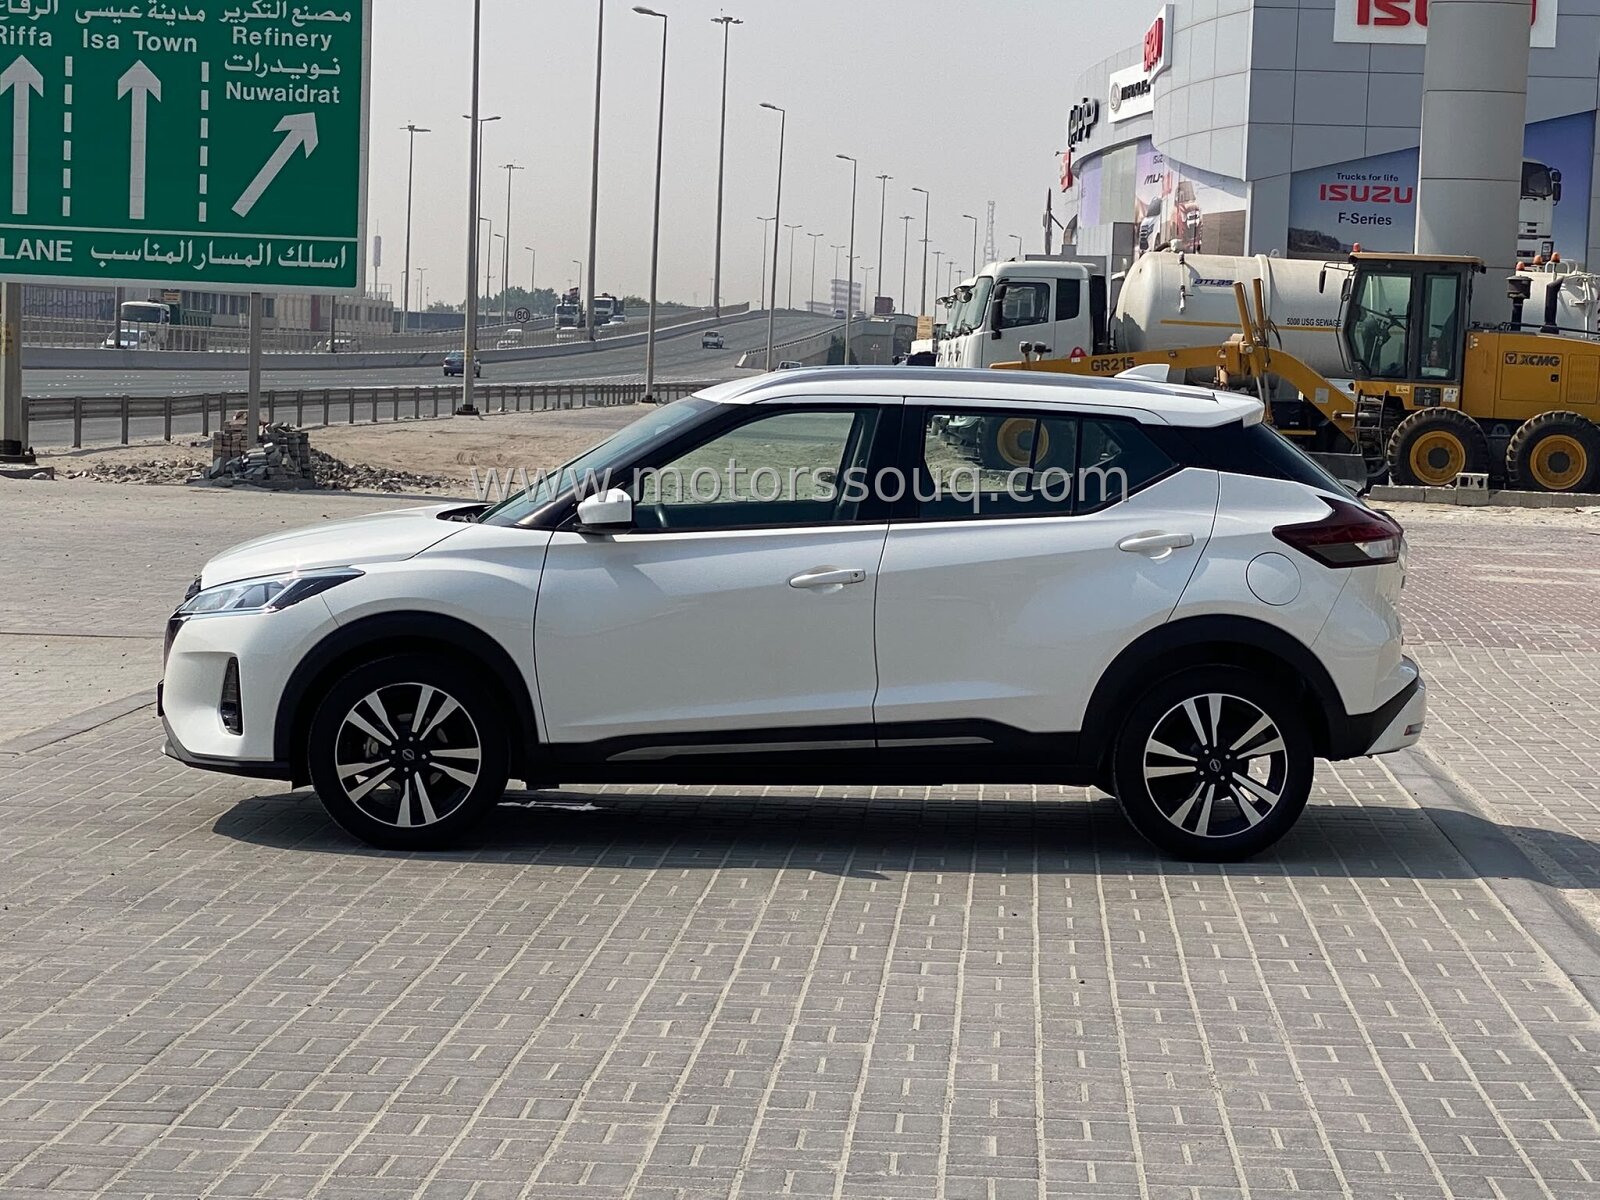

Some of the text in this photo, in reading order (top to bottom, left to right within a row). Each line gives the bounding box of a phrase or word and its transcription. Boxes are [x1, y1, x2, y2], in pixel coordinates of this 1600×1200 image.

[75, 0, 206, 26] مدينة عيسى
[218, 0, 352, 27] مصنع التكرير
[0, 24, 52, 47] Riffa
[82, 28, 198, 53] Isa Town
[232, 26, 333, 52] Refinery
[224, 51, 341, 80] نويدرات
[225, 81, 340, 104] Nuwaidrat
[1337, 172, 1399, 182] Trucks for life
[1319, 184, 1414, 204] ISUZU
[1338, 211, 1393, 226] F-Series
[0, 237, 73, 262] LANE
[90, 237, 347, 271] اسلك المسار المناسب
[1301, 318, 1315, 326] USG
[1315, 319, 1341, 327] SEWAGE
[1090, 356, 1135, 372] GR215
[1520, 354, 1561, 367] XCMG
